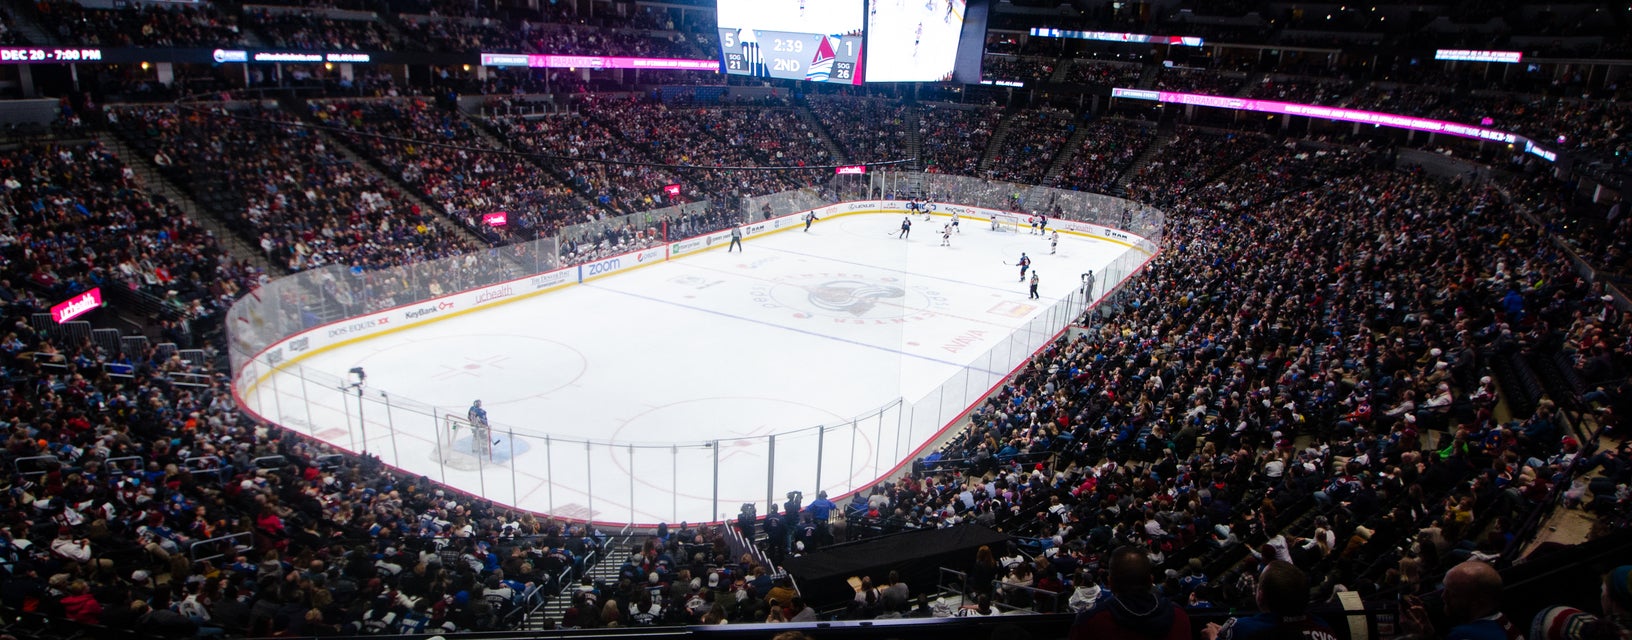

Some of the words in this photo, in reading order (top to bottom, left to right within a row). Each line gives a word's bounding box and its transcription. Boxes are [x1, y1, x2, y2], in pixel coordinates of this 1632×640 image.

[725, 32, 734, 47] 5
[773, 39, 803, 53] 2:39
[0, 49, 28, 60] DEC
[29, 49, 45, 60] 20
[54, 49, 80, 60] 7:00
[81, 49, 102, 60] PM
[845, 41, 853, 56] 1
[730, 61, 741, 70] 21
[773, 58, 800, 72] 2ND
[837, 62, 850, 70] SOG
[837, 69, 850, 79] 26
[1185, 95, 1240, 107] PARAMOUN
[589, 258, 620, 275] zoom
[474, 285, 514, 304] uchealth
[60, 293, 98, 323] uchealth
[405, 306, 438, 319] KeyBank
[328, 327, 348, 338] DOS
[349, 320, 376, 333] EQUIS
